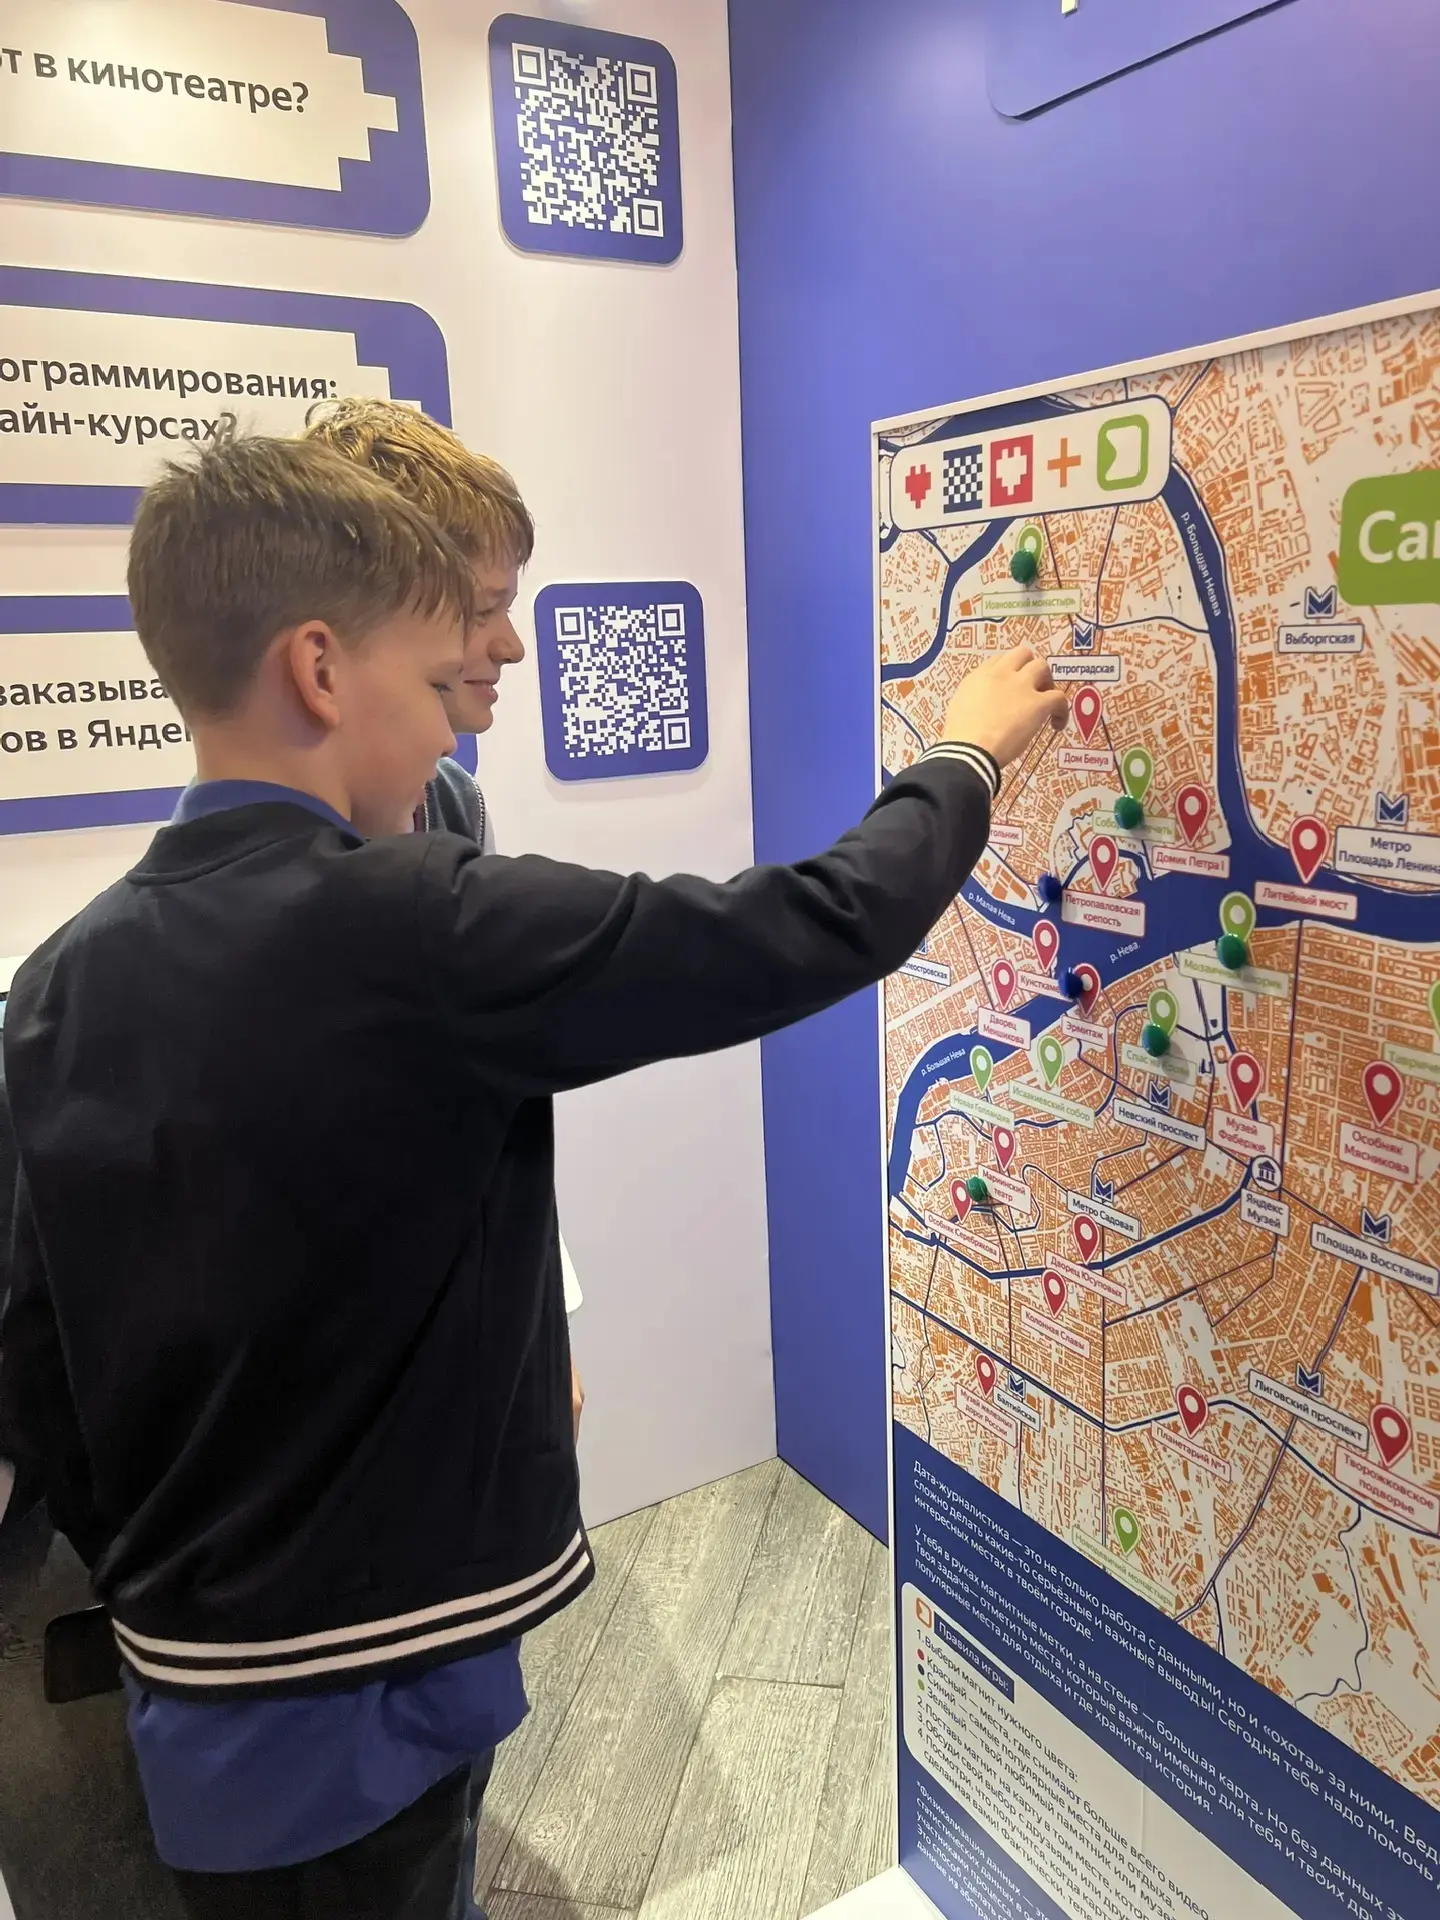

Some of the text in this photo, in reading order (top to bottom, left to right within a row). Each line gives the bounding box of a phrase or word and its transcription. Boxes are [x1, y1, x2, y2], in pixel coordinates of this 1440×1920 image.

[34, 52, 309, 113] в кинотеатре?
[0, 358, 337, 399] ограммирования:
[1187, 523, 1210, 578] Большая
[1359, 510, 1440, 563] Са
[1285, 632, 1355, 648] Выборгская
[1051, 663, 1115, 675] Петроградская
[57, 729, 78, 750] в
[1064, 752, 1109, 767] Дом Бенуа
[1156, 851, 1186, 867] Домик
[1188, 856, 1220, 871] Петра
[1338, 850, 1393, 869] Площадь
[1370, 836, 1412, 853] Метро
[968, 892, 1016, 926] р. Малая Нева
[1065, 893, 1141, 916] Петропавловская
[1262, 888, 1348, 911] Литейный мост
[1083, 912, 1121, 928] крепость
[1109, 953, 1119, 964] р.
[1020, 975, 1060, 993] Кунсткаме
[989, 1014, 1017, 1032] Дворец
[1065, 1021, 1104, 1041] Эрмитаж
[926, 1056, 951, 1072] Большая
[950, 1048, 966, 1063] Нева
[1066, 1105, 1090, 1122] собор
[1118, 1106, 1199, 1143] Невский проспект
[1226, 1117, 1258, 1137] Музей
[1344, 1143, 1409, 1174] Мясникова
[1352, 1130, 1403, 1155] Особняк
[994, 1187, 1013, 1203] театр
[1246, 1192, 1284, 1216] Яндекс
[1072, 1198, 1134, 1233] Метро Садовая
[1247, 1208, 1281, 1230] Музей
[1316, 1231, 1434, 1287] Площадь Восстания
[1050, 1255, 1123, 1298] Дворец Юсуповых
[997, 1393, 1037, 1425] Балтийская
[1254, 1378, 1362, 1441] Лиговский проспект
[1155, 1426, 1210, 1465] Планетарий
[1343, 1452, 1435, 1511] Творожковское
[1358, 1477, 1415, 1516] подворье
[913, 1494, 1094, 1642] интересных местах в твоём городе.
[913, 1459, 1398, 1833] Дата-журналистика это не только работа с данными, но и «охота» за ними.
[938, 1620, 1008, 1691] Правила игры:
[913, 1478, 1433, 1881] сложно делать какие-то серьёзные и важные выводы! Сегодня тебе надо помочь
[914, 1558, 1213, 1815] популярные места для отдыха и где хранится история.
[914, 1523, 1383, 1911] У тебя в руках магнитные метки, а на стене большая карта. Но без данных
[914, 1539, 936, 1566] Твоя
[979, 1596, 1027, 1641] отметить
[1029, 1636, 1064, 1673] места,
[1066, 1667, 1116, 1715] которые
[1117, 1709, 1161, 1752] важны
[1163, 1746, 1216, 1796] именно
[1218, 1792, 1244, 1820] для
[1247, 1815, 1282, 1851] тебя
[1285, 1846, 1294, 1861] и
[1297, 1856, 1344, 1902] твоих
[961, 1670, 995, 1706] магнит
[996, 1703, 1042, 1749] нужного
[1043, 1745, 1077, 1783] цвета:
[926, 1655, 967, 1700] Красный
[979, 1706, 1011, 1743] места,
[1012, 1737, 1031, 1759] где
[1031, 1755, 1081, 1805] снимают
[1082, 1799, 1128, 1849] больше
[1129, 1845, 1165, 1882] всего
[926, 1685, 1136, 1893] Зелёный твой любимый памятник или
[926, 1671, 1175, 1911] Синий самые популярные места для отдыха.
